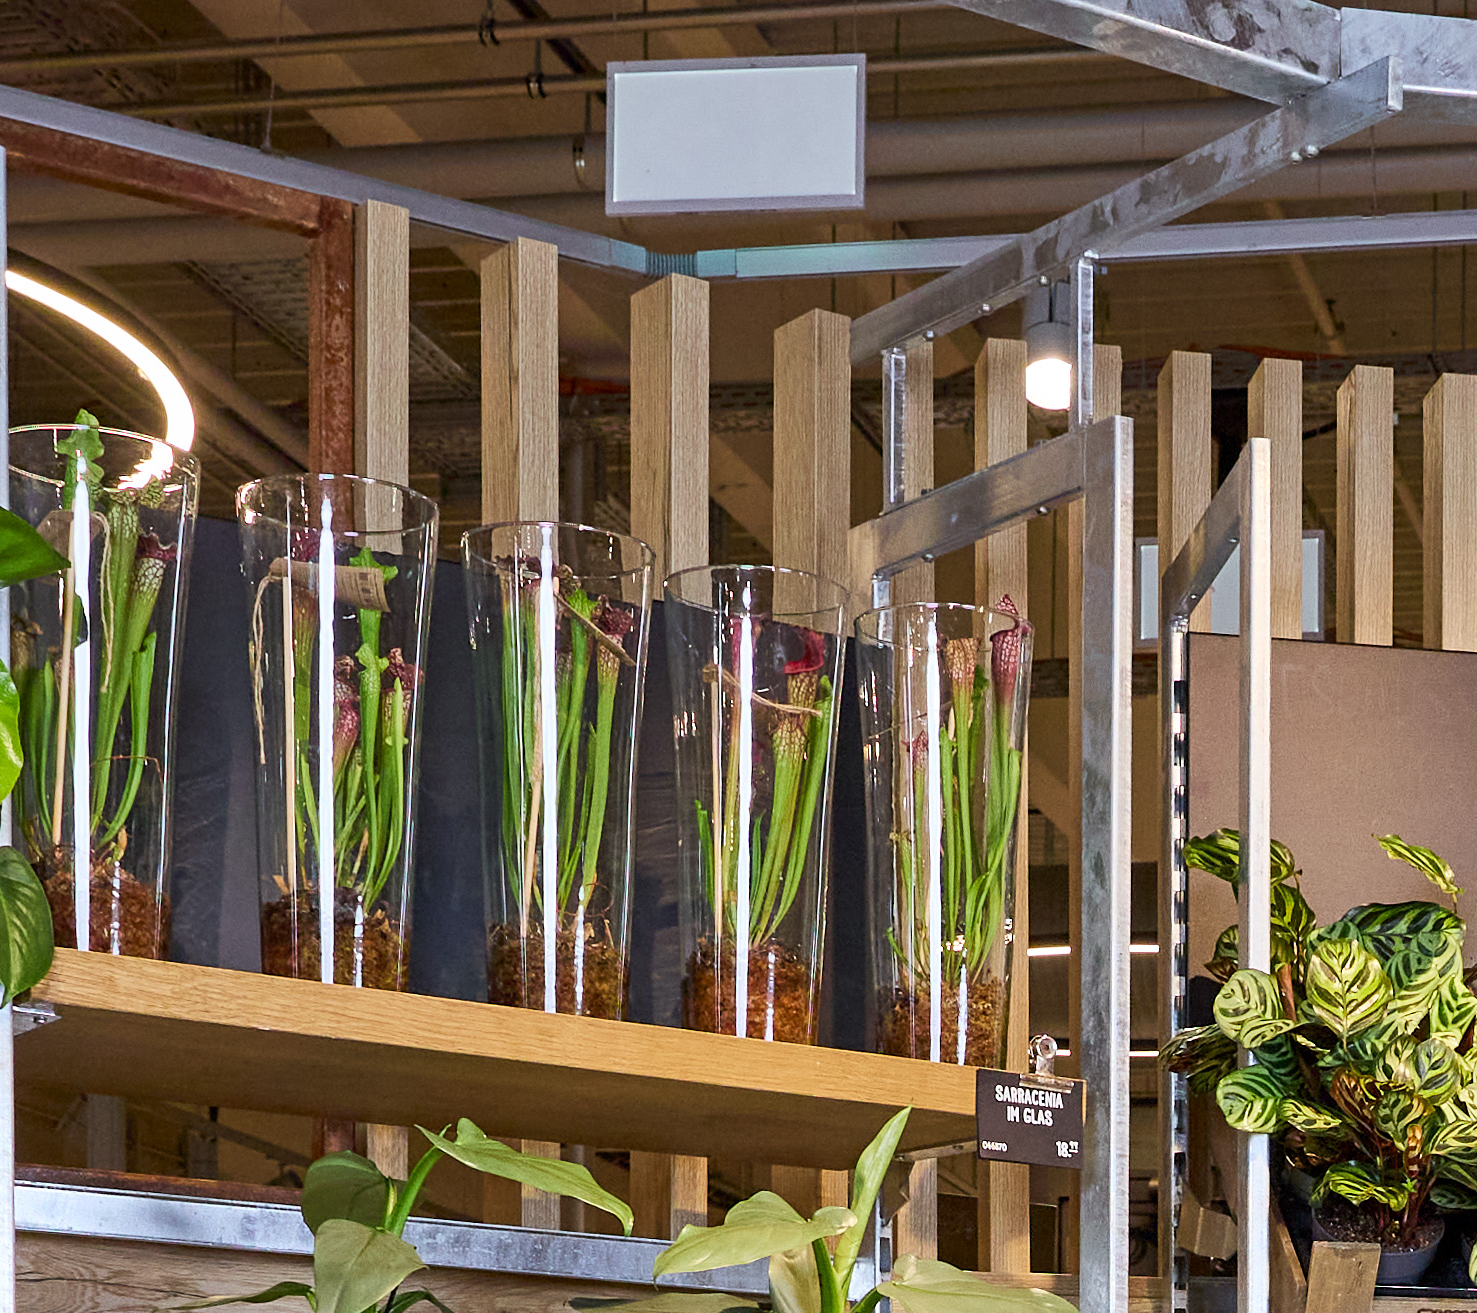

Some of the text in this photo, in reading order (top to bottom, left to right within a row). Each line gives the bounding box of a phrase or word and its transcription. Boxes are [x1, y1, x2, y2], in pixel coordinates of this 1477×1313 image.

[994, 1085, 1064, 1109] SARRACENIA
[1007, 1106, 1054, 1127] IM GLAS
